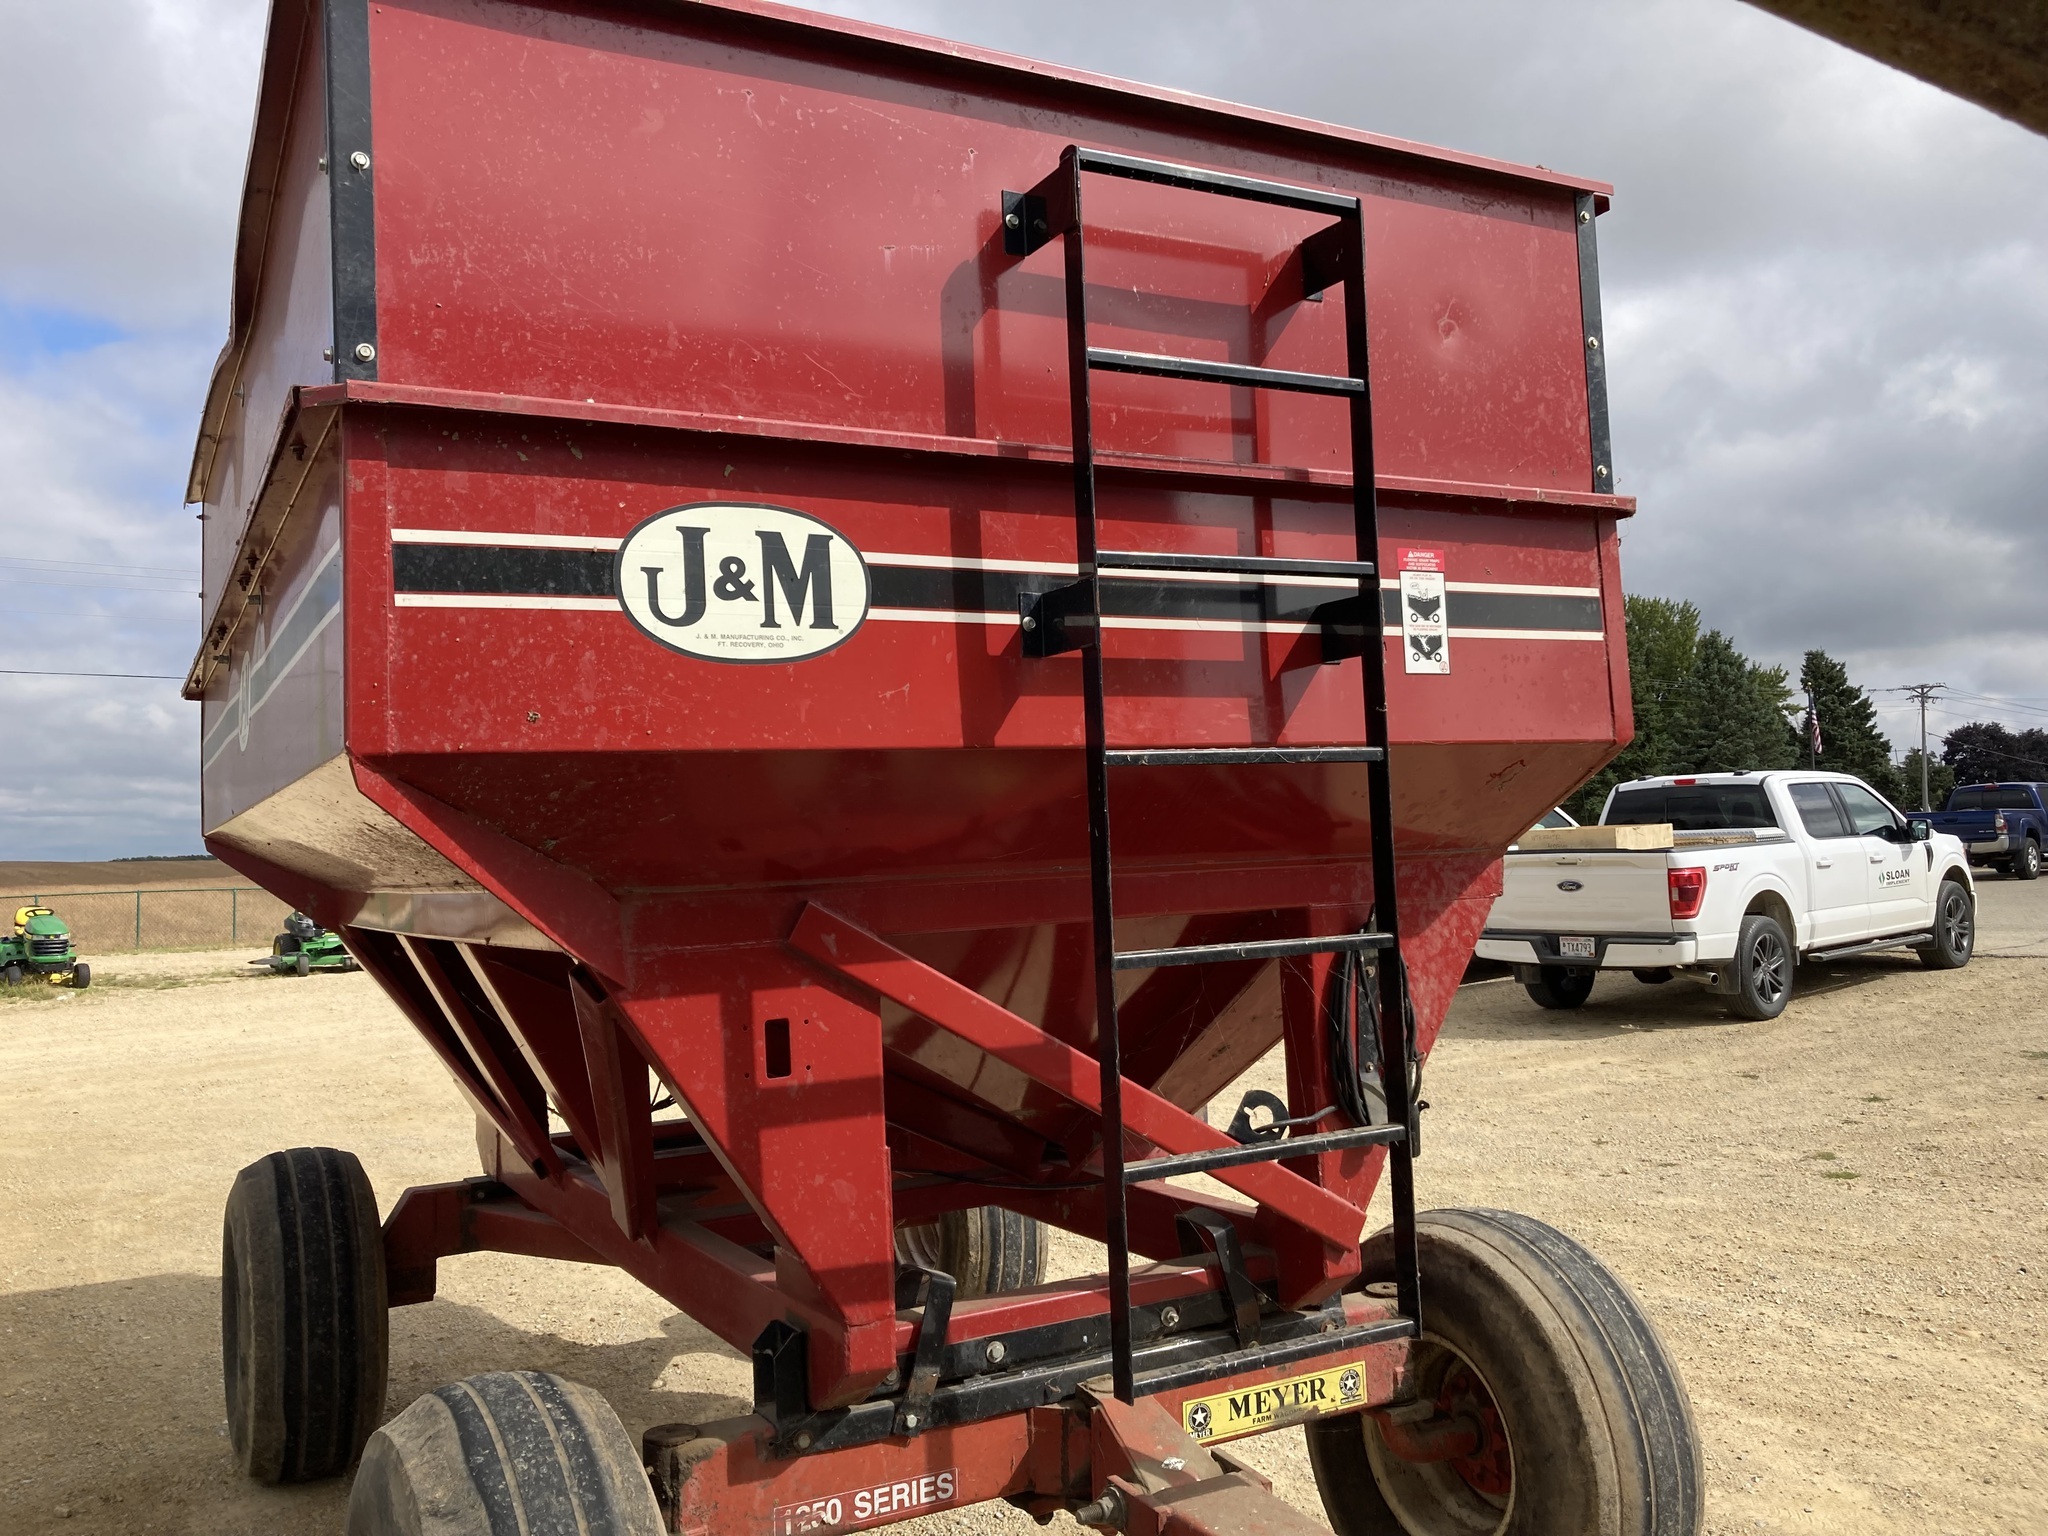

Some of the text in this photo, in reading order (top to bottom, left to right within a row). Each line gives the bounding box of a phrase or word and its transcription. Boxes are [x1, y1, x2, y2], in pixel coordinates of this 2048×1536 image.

[640, 525, 839, 630] J&M
[1886, 869, 1910, 881] SLOAN
[1229, 1377, 1326, 1421] MEYER
[1252, 1415, 1272, 1425] FARM
[854, 1473, 954, 1519] SERIES
